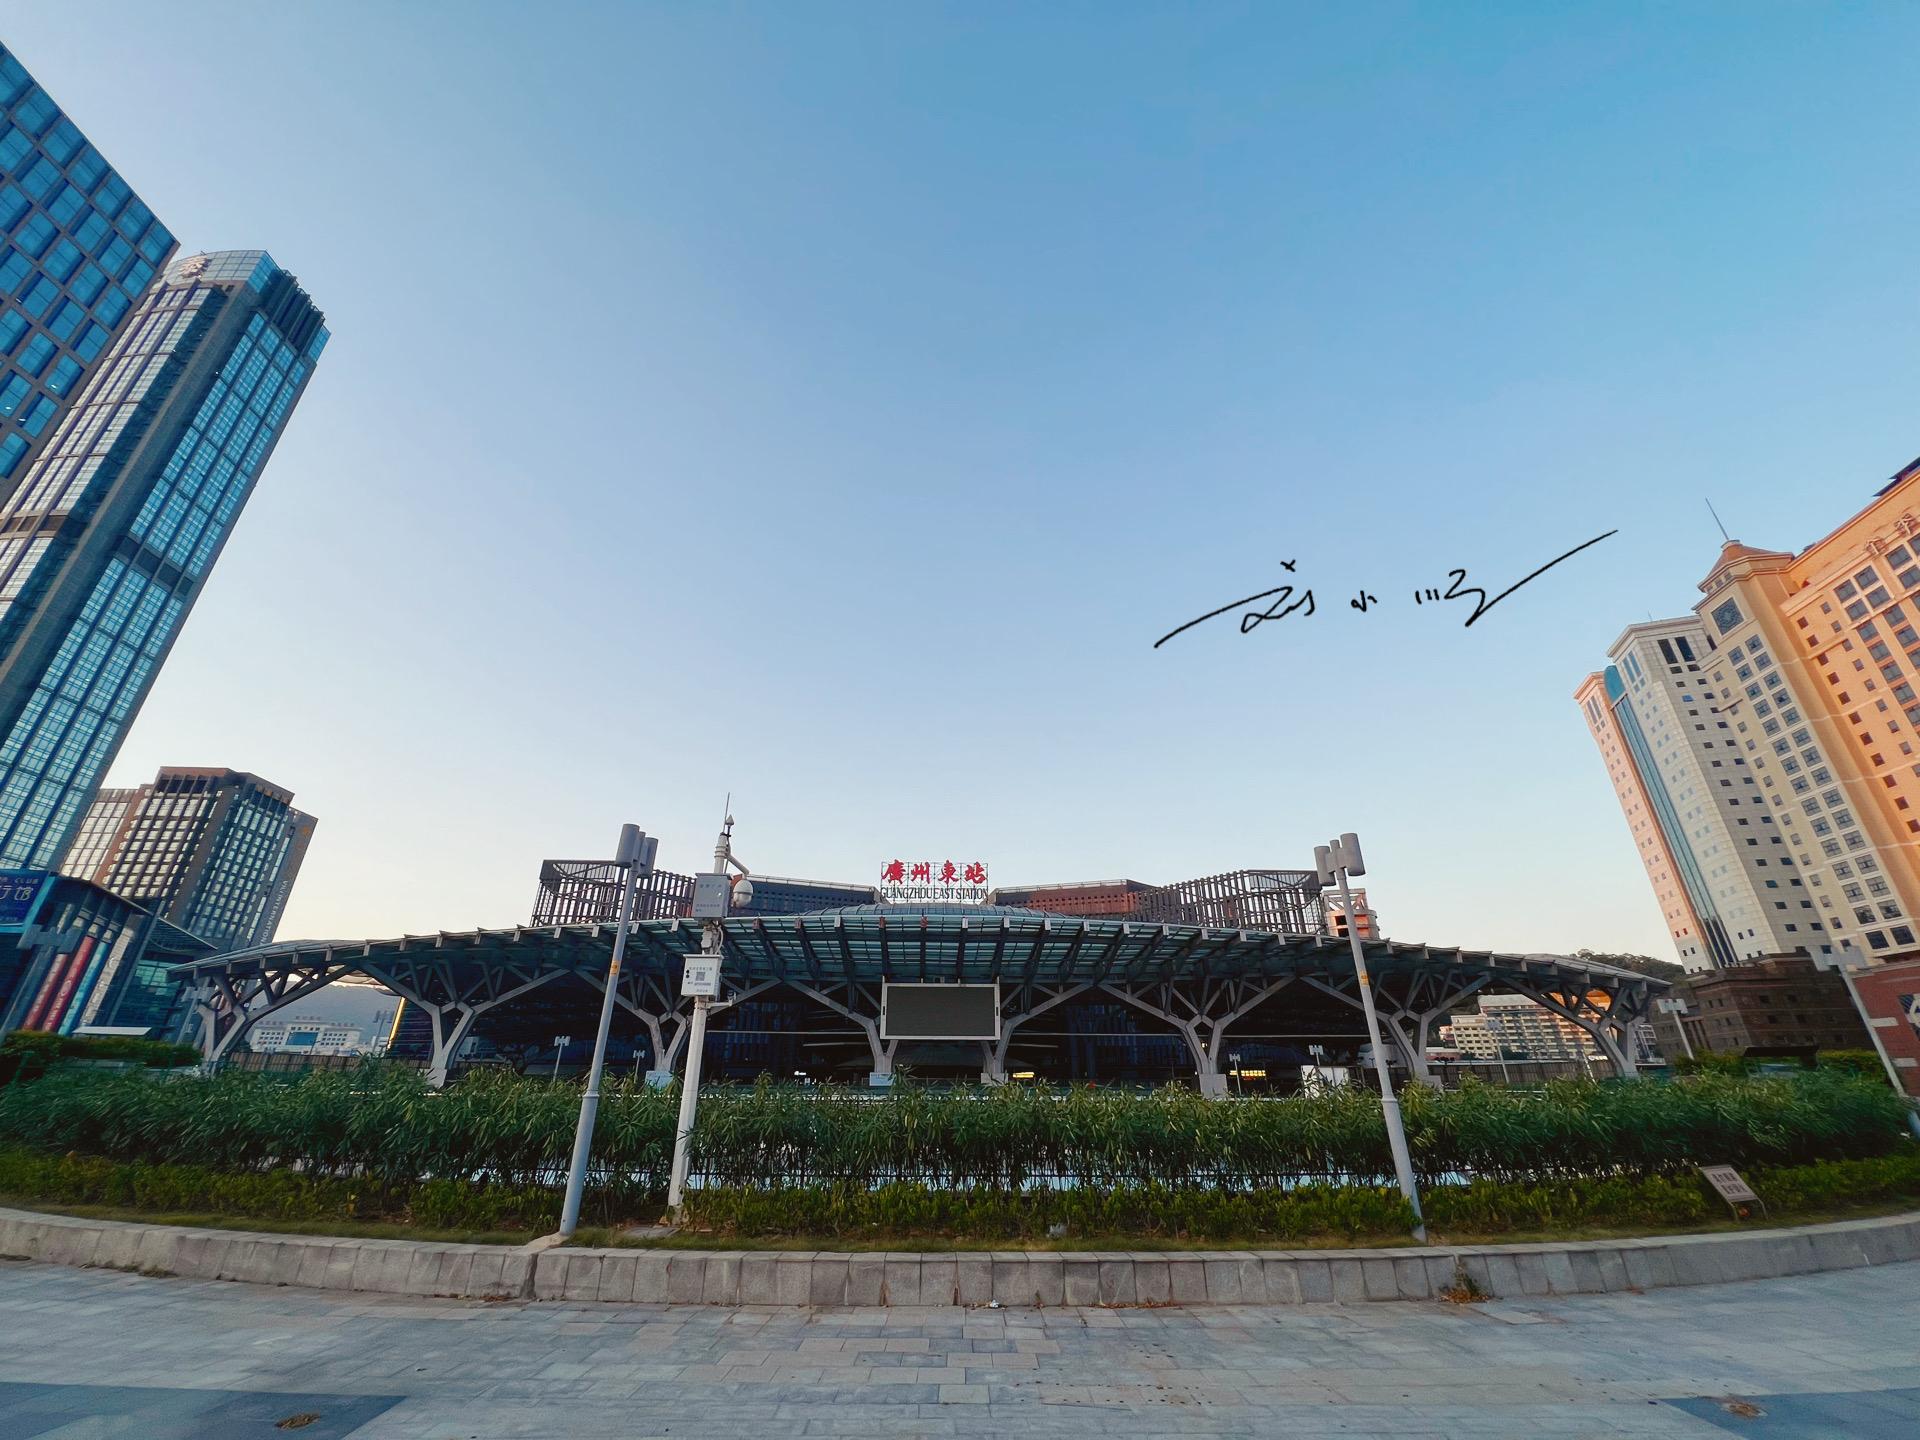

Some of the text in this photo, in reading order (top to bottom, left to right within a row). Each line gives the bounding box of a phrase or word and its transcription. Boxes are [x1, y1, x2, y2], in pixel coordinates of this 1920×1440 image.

[881, 887, 988, 899] GUANGZHOU EAST STATION
